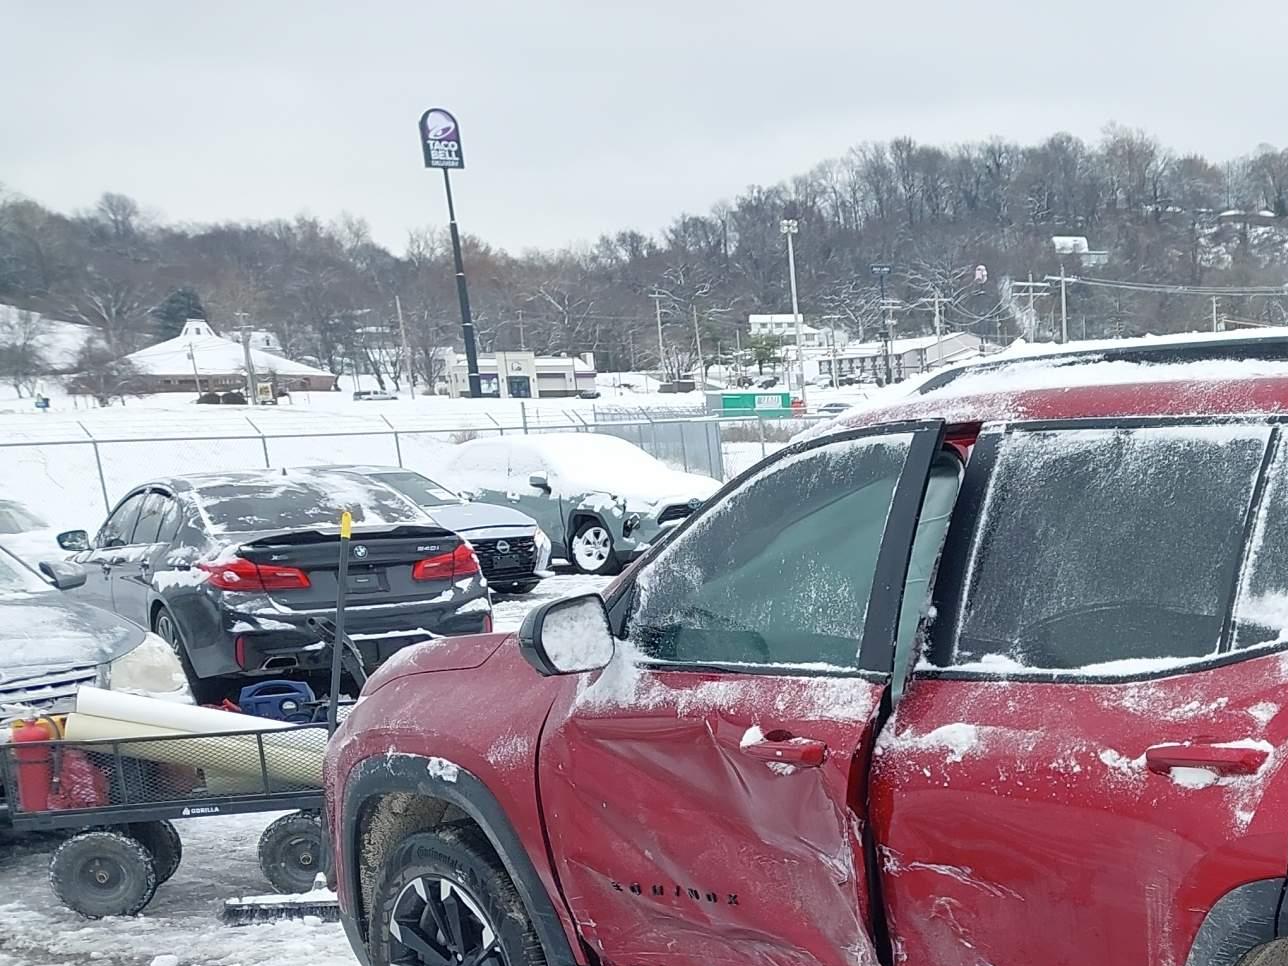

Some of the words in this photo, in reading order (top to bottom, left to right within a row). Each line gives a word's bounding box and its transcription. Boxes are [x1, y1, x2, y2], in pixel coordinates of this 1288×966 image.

[427, 140, 458, 151] TACO
[431, 150, 460, 160] BELL
[417, 846, 458, 871] Continental
